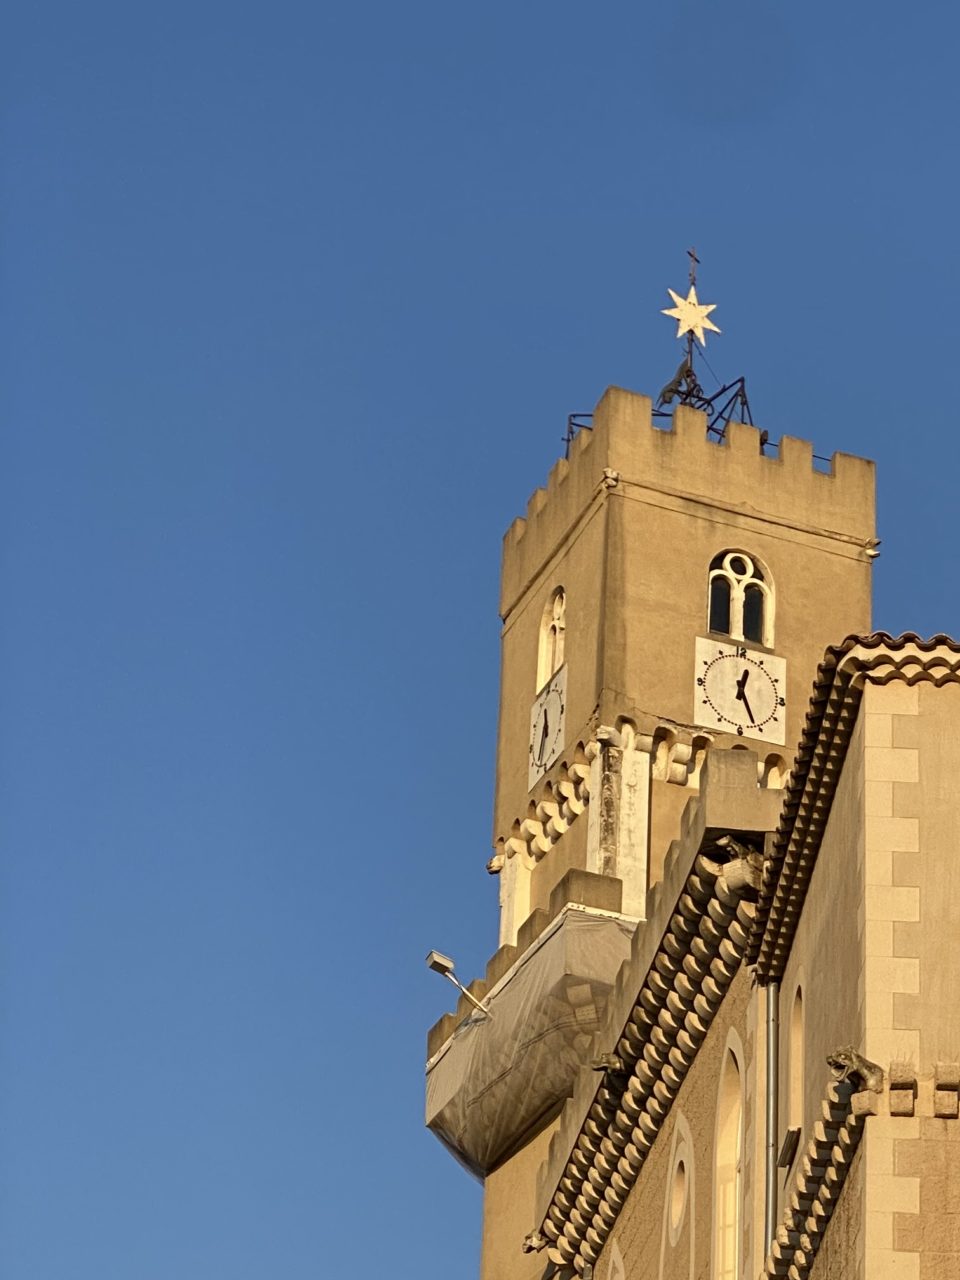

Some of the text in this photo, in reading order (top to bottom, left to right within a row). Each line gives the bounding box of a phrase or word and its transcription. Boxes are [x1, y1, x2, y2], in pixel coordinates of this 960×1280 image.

[736, 646, 747, 657] 12
[697, 677, 704, 686] 9
[779, 697, 786, 706] 3
[737, 726, 744, 736] 6
